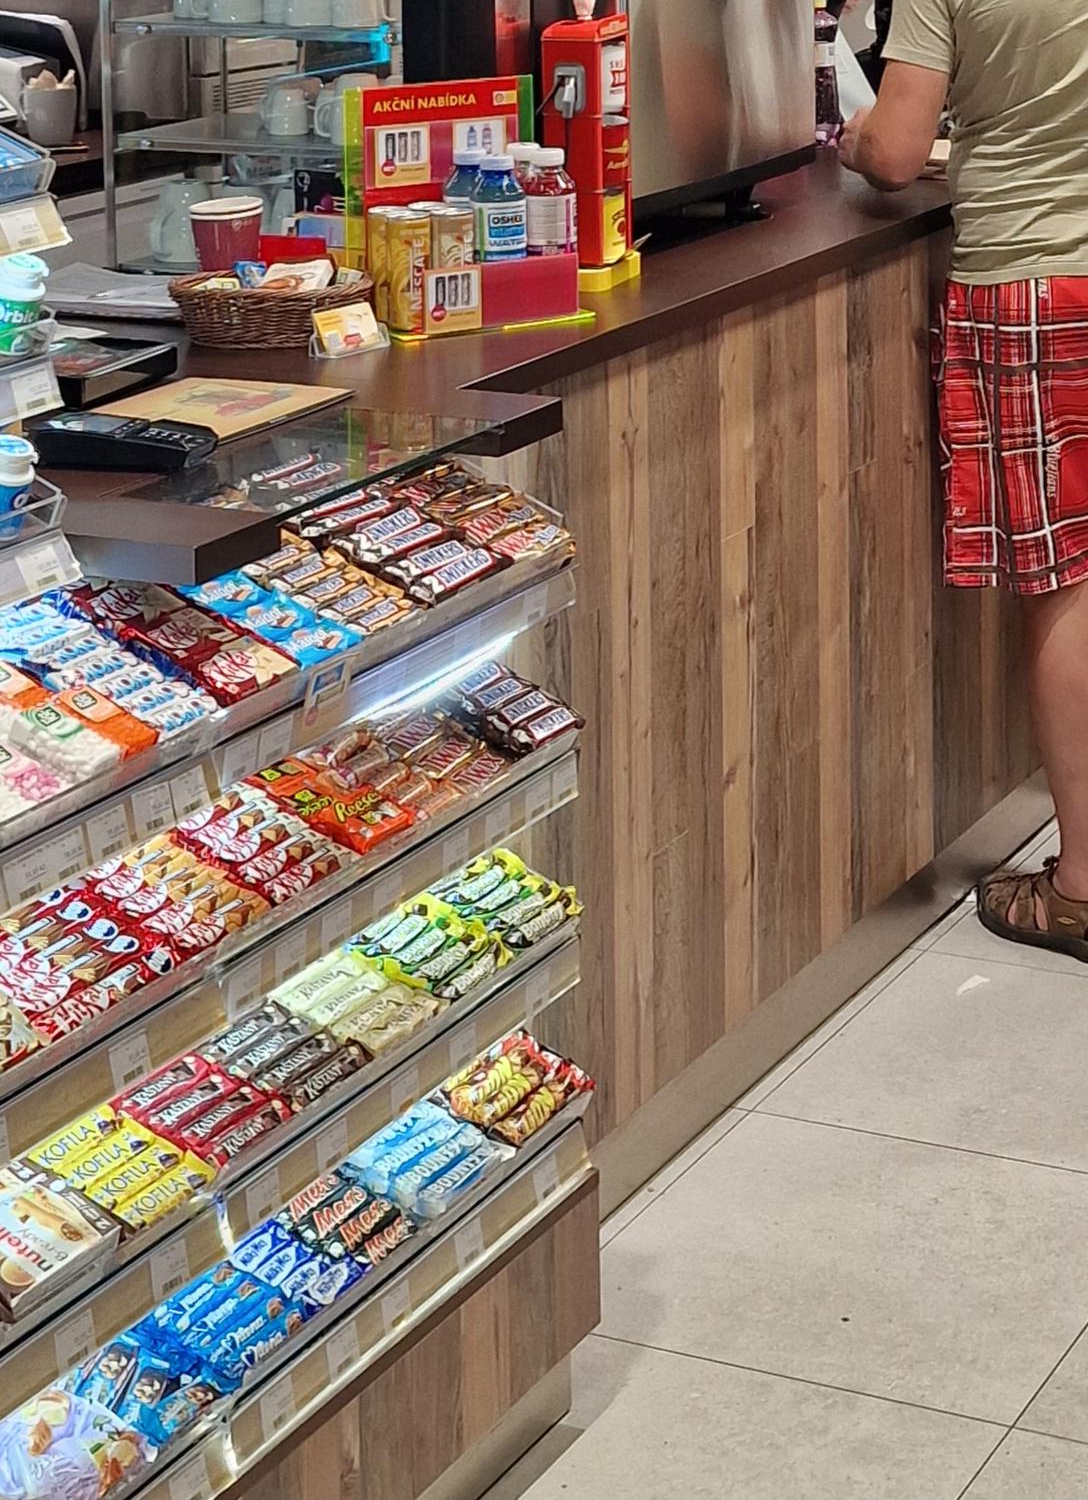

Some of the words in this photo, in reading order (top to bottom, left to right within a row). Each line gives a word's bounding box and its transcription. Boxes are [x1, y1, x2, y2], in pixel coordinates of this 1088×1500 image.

[373, 94, 415, 114] AKČNÍ
[417, 92, 477, 110] NABÍDKA
[438, 549, 492, 586] SNICKERS
[38, 1124, 96, 1166] KOFILA
[72, 1143, 128, 1183] KOFILA
[102, 1159, 156, 1199] KOFILA
[131, 1177, 185, 1219] KOFILA
[313, 1185, 368, 1239] Mars
[339, 1198, 392, 1251] Mars
[0, 1223, 53, 1272] nutell
